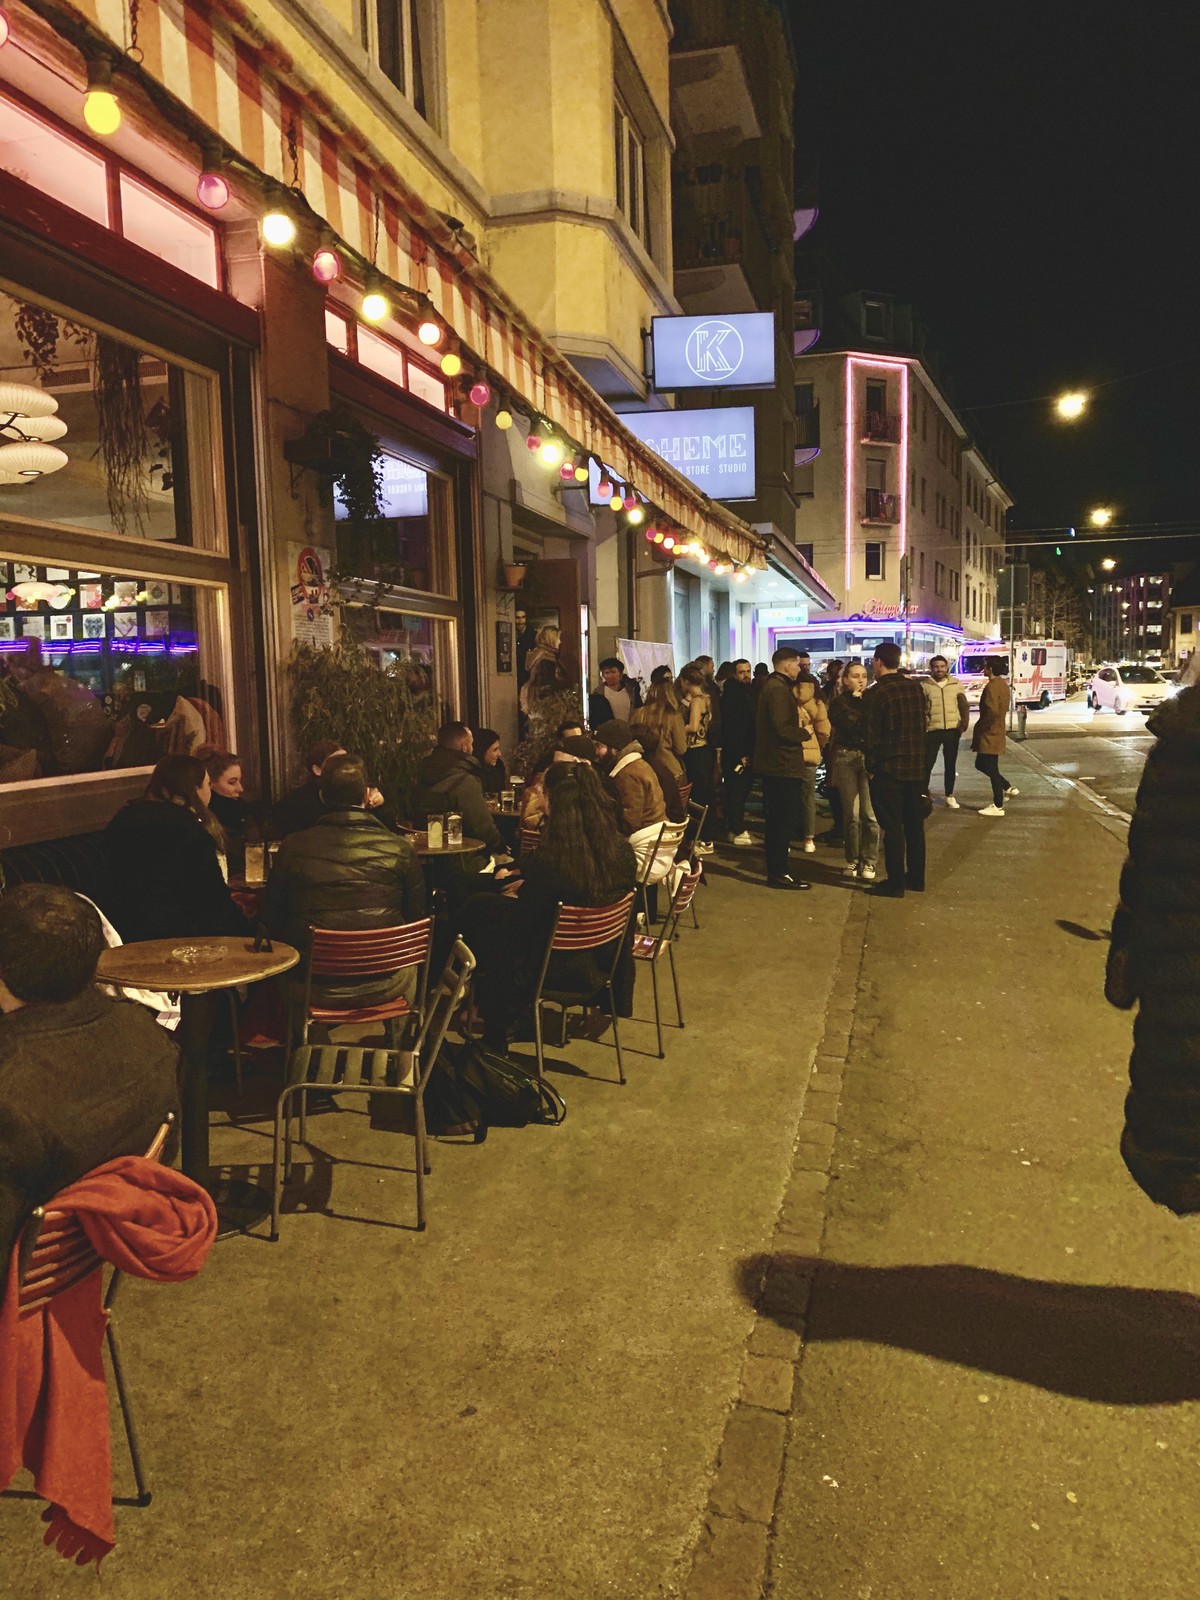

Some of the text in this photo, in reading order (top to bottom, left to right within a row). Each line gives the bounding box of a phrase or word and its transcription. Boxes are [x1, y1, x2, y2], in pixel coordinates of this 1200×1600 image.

[695, 330, 734, 373] K
[686, 465, 710, 476] STORE
[718, 463, 747, 474] STUDIO
